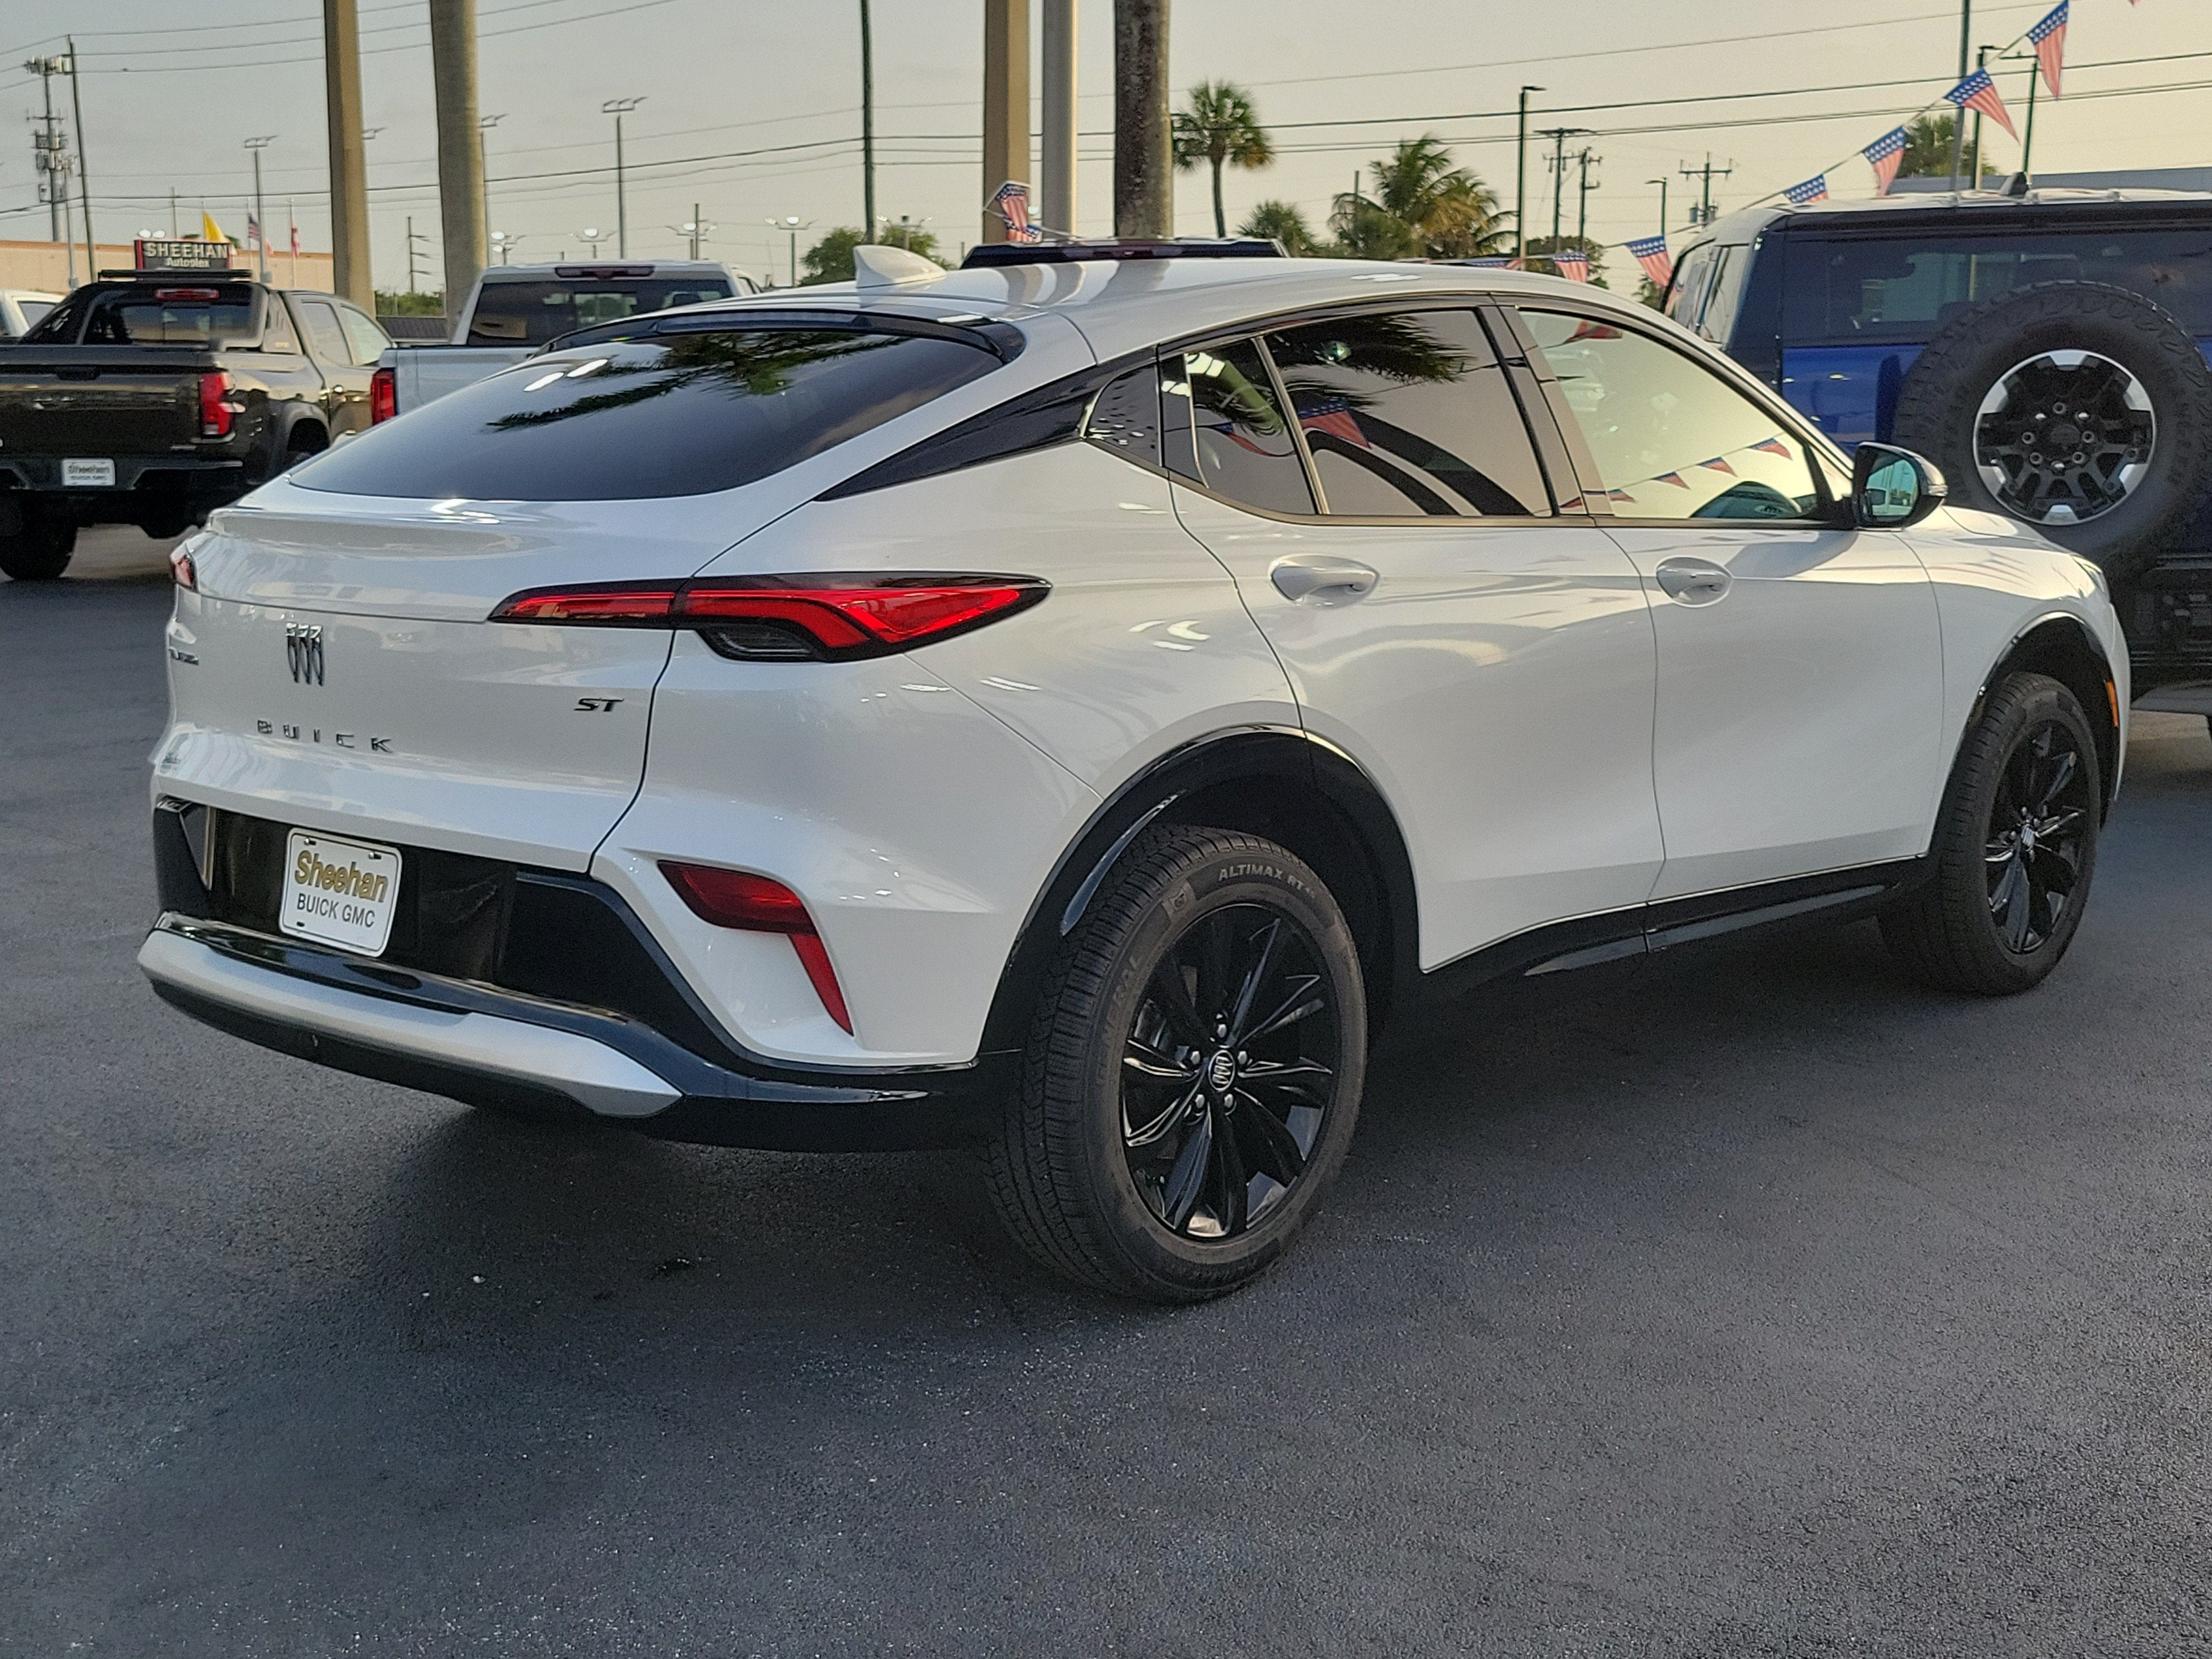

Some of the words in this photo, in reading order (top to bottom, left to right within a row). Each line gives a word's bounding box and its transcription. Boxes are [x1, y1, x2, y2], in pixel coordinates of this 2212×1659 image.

[144, 242, 228, 259] SHEEHAN
[573, 698, 625, 712] ST
[257, 719, 393, 753] BUICK
[294, 850, 389, 904] Sheehan
[1218, 864, 1283, 882] ALTIMAX
[297, 892, 340, 920] BUICK
[341, 904, 375, 928] GMC
